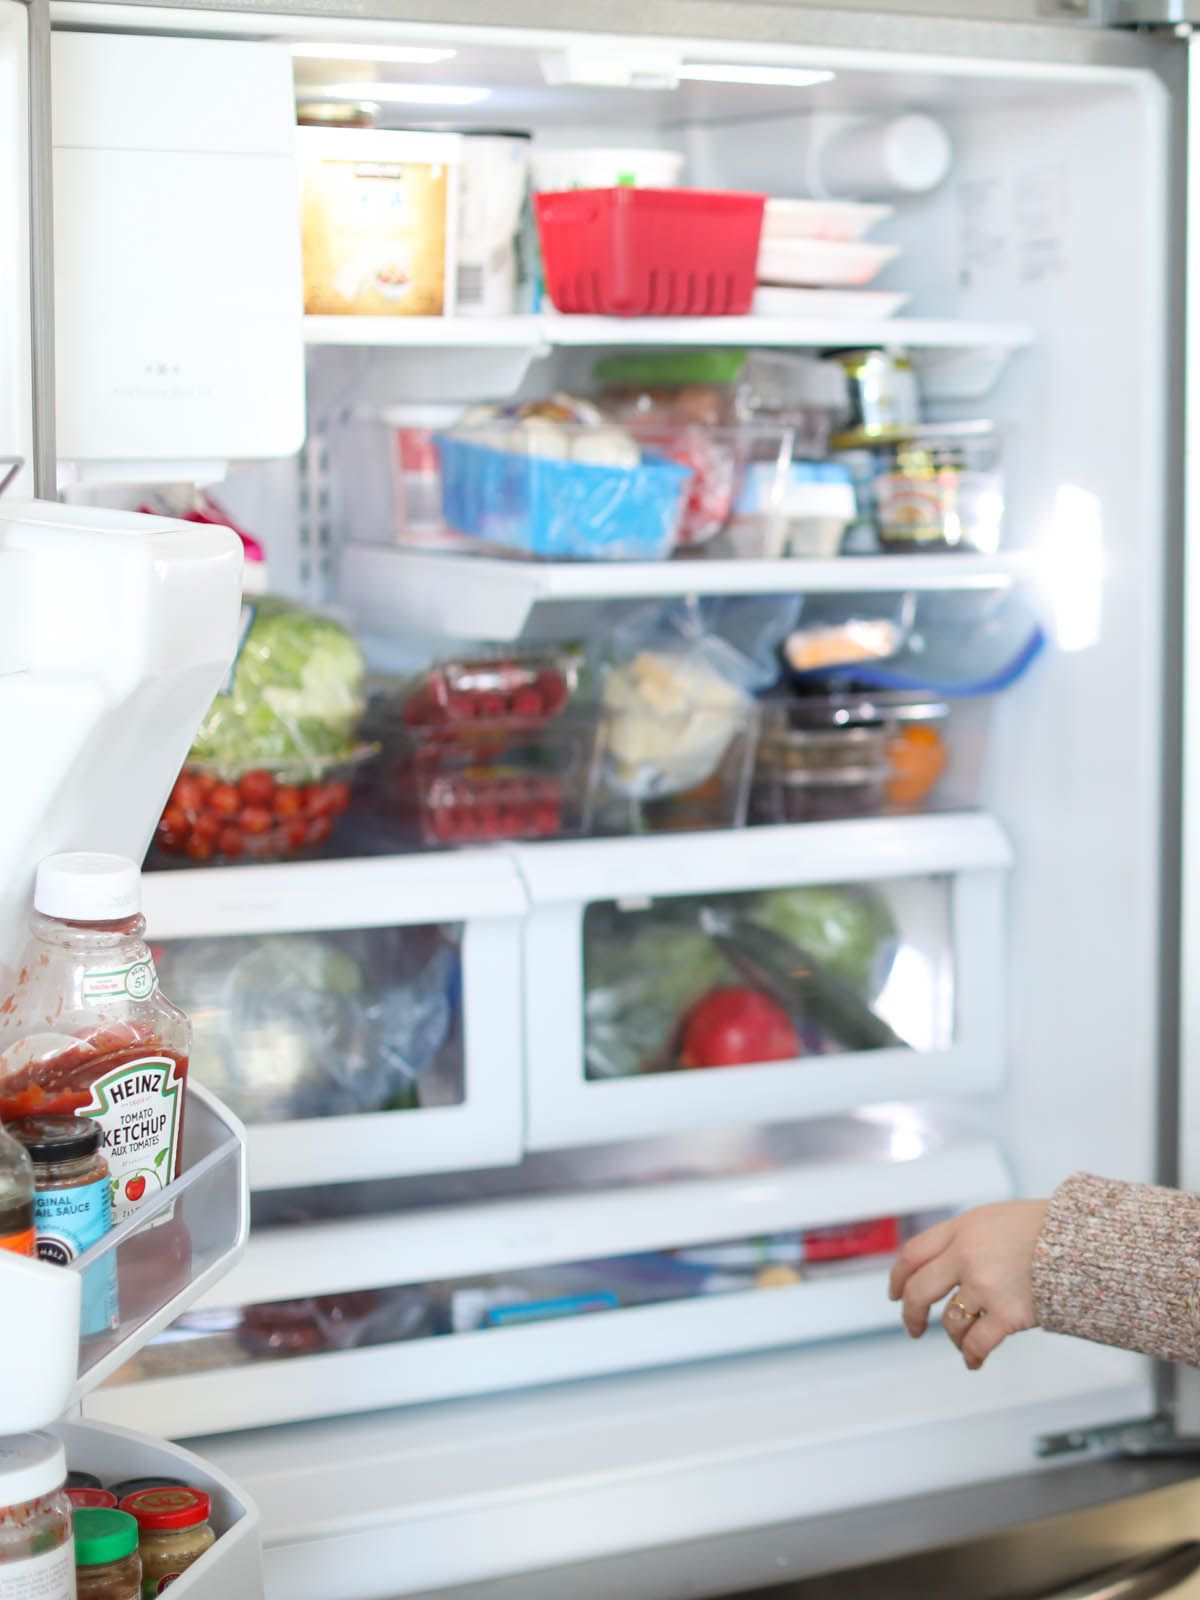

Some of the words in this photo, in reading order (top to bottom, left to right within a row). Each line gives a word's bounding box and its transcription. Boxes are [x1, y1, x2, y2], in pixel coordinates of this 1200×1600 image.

[135, 974, 146, 989] 57
[110, 1074, 162, 1104] HEINZ
[120, 1107, 153, 1126] TOMATO
[102, 1114, 167, 1149] KETCHUP
[111, 1146, 127, 1158] AUX
[129, 1135, 160, 1153] TOMATES
[35, 1196, 72, 1207] GINAL
[35, 1208, 53, 1218] AIL
[55, 1202, 91, 1217] SAUCE
